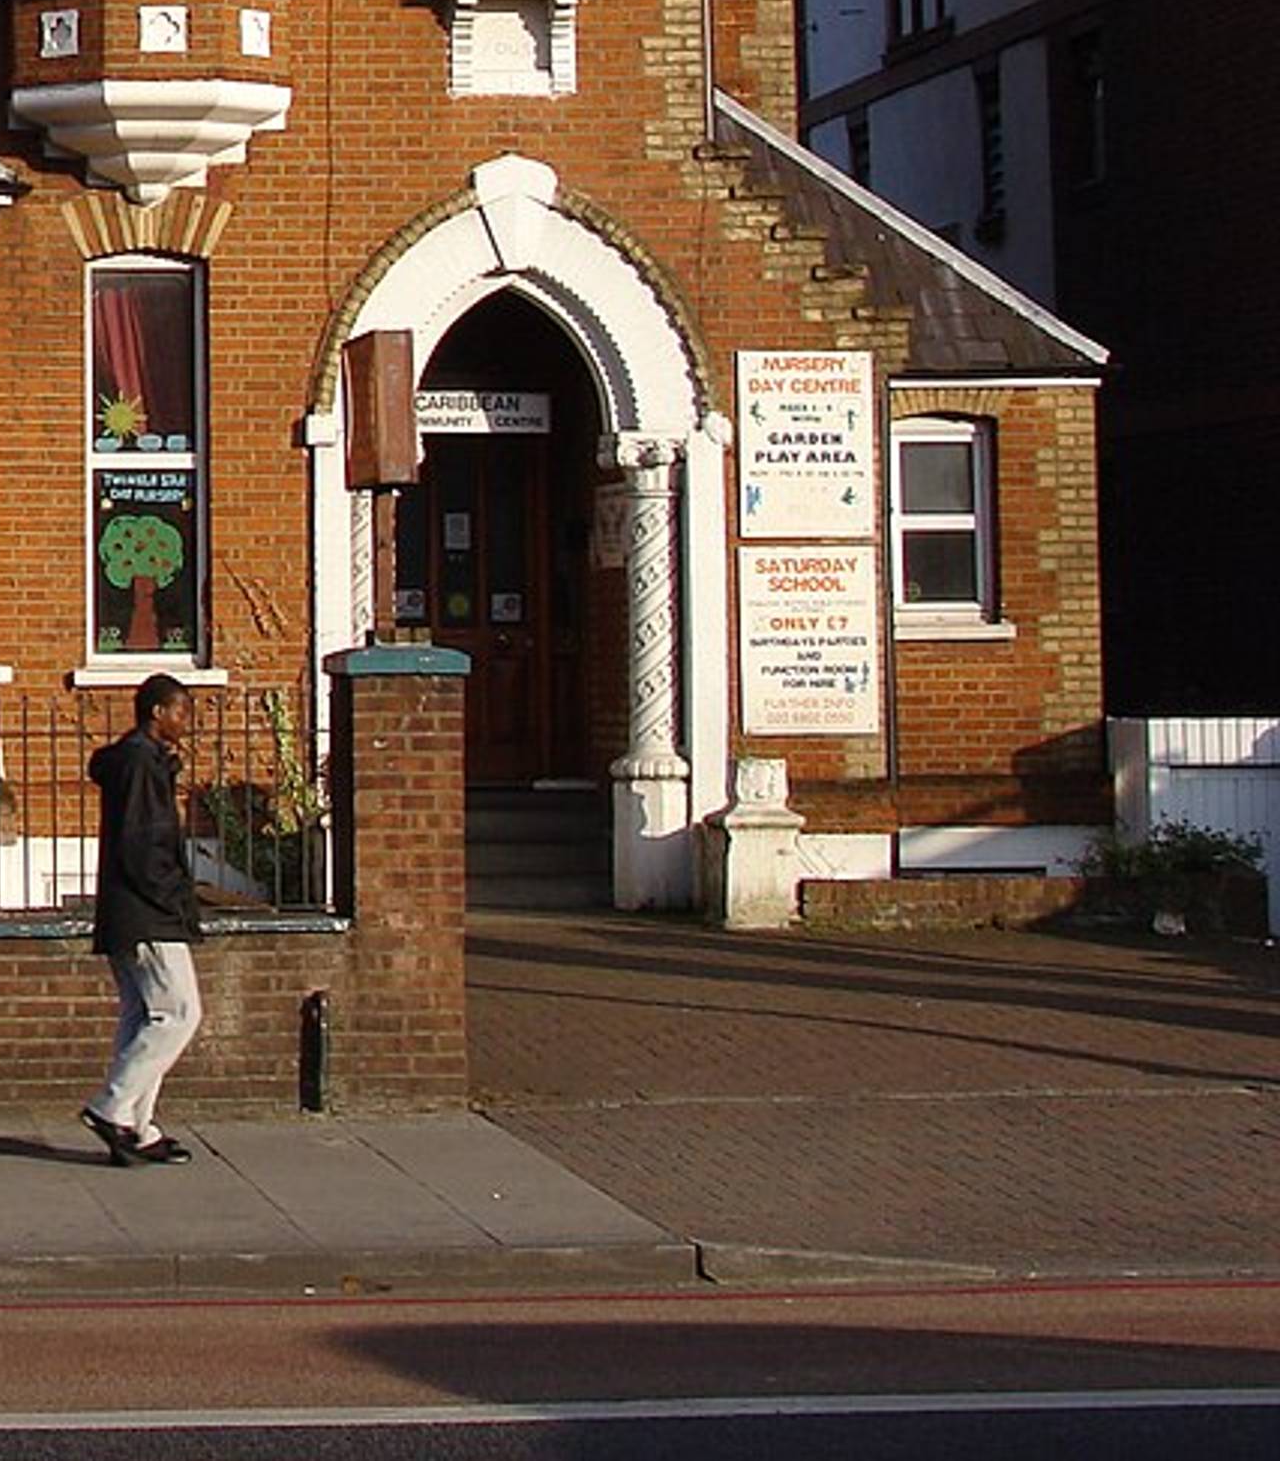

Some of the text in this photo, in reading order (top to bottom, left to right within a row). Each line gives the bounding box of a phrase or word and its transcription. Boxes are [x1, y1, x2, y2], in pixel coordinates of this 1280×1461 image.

[761, 356, 847, 373] NURSERY
[748, 378, 862, 394] DAY CENTRE
[413, 395, 520, 412] CARIBBEAN
[494, 417, 545, 428] CENTRE
[767, 431, 843, 446] GARDEN
[754, 450, 858, 463] PLAY AREA
[754, 557, 859, 574] SATURDAY
[767, 576, 847, 592] SCHOOL
[769, 617, 820, 631] ONLY
[818, 636, 868, 647] PARTIES
[796, 651, 823, 661] AND
[760, 665, 858, 676] FUNCTION ROOM
[782, 678, 836, 688] FOR HIRE
